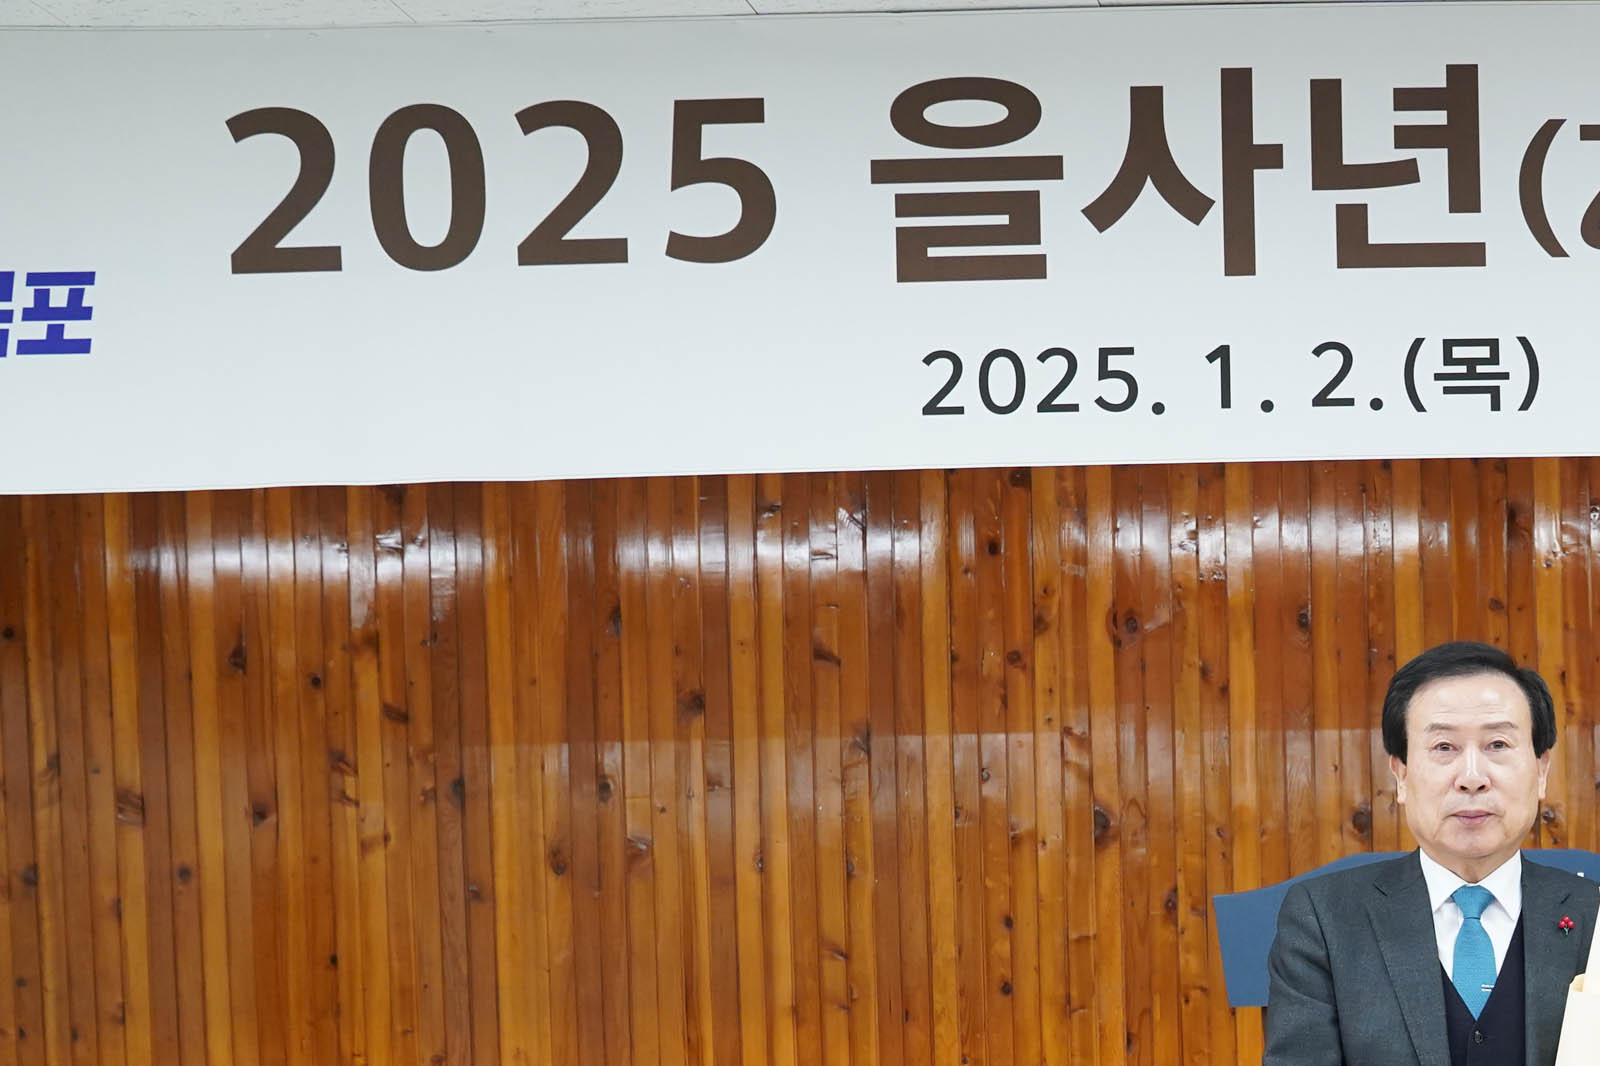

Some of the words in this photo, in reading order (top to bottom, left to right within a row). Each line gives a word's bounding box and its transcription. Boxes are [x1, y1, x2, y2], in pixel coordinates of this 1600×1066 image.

[225, 97, 777, 275] 2025
[0, 270, 97, 358] 포
[921, 346, 1166, 416] 2025.
[1205, 344, 1275, 413] 1.
